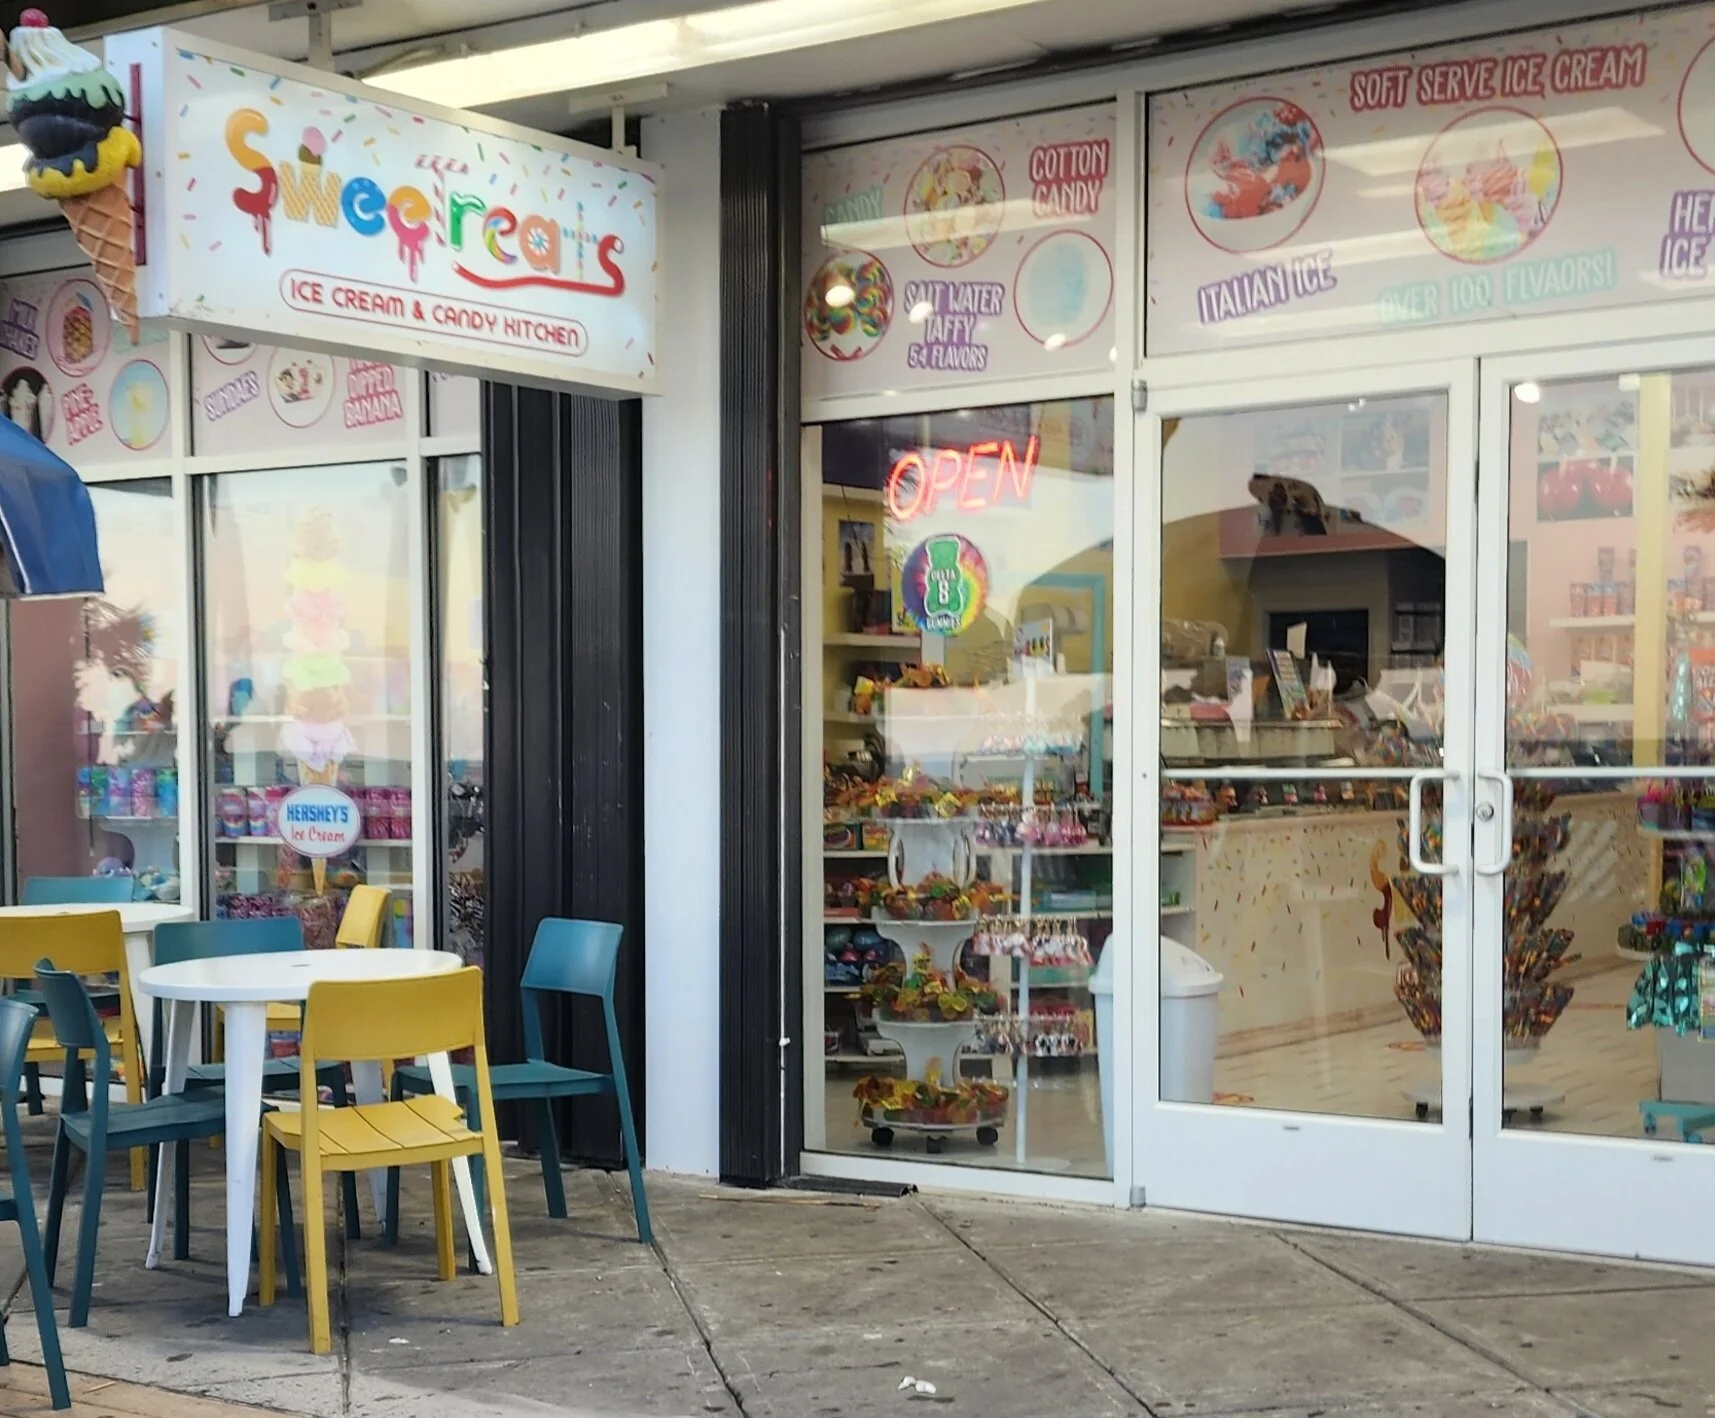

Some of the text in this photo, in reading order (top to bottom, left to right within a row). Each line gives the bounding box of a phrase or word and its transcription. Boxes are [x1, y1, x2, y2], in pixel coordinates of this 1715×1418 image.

[1352, 48, 1645, 107] SOFT SERVE ICE CREAM
[1032, 142, 1107, 181] COTTON
[825, 188, 882, 223] CANDY
[1035, 179, 1101, 217] CANDY
[1662, 236, 1706, 278] ICE
[905, 282, 1004, 315] SALT WATER
[1199, 251, 1336, 324] ITALIAN ICE
[1383, 284, 1438, 321] OVER
[1451, 275, 1491, 313] 100
[290, 278, 580, 349] ICE CREAM & CANDY KITCHEN
[926, 315, 975, 343] TAFFY
[930, 345, 988, 370] FLAVORS
[205, 370, 259, 421] SUNDAES
[349, 367, 393, 398] DIPPED
[345, 391, 403, 428] BANANA
[887, 434, 1041, 522] OPEN
[938, 580, 950, 605] 8
[287, 803, 349, 823] HERSHEY'S
[291, 825, 346, 842] Ice Cream
